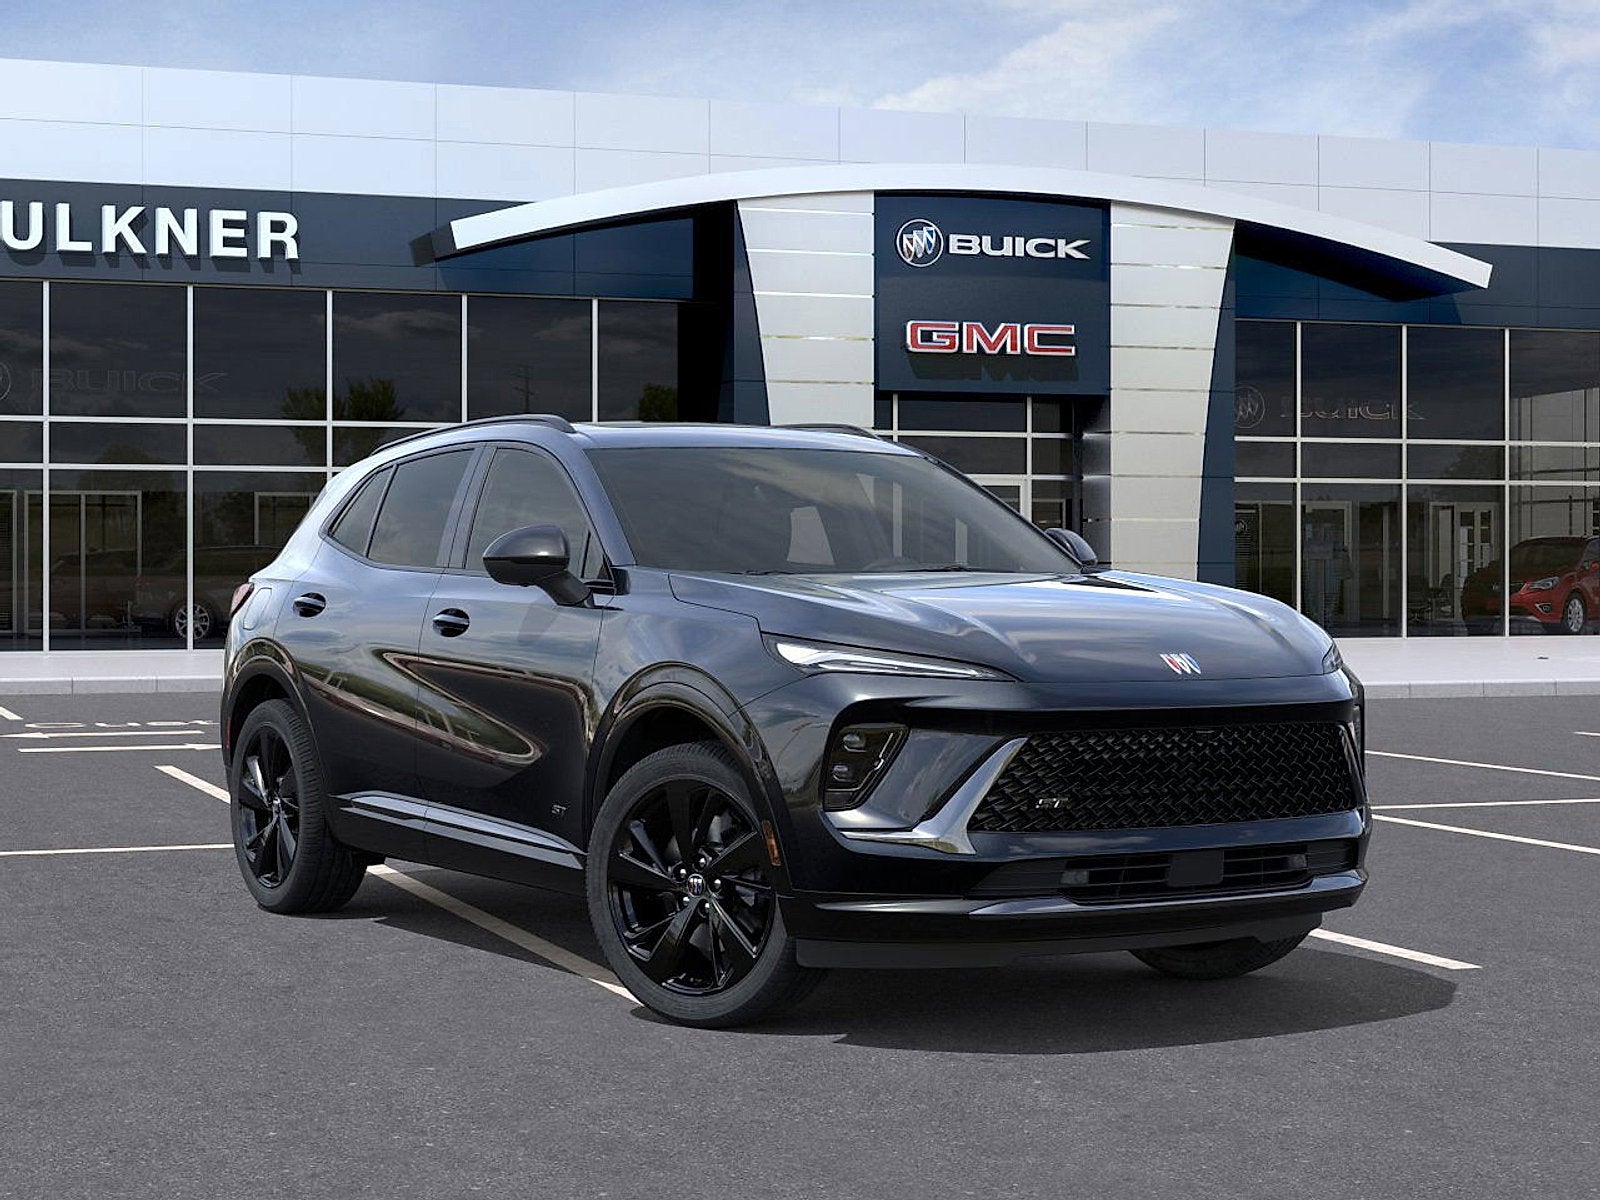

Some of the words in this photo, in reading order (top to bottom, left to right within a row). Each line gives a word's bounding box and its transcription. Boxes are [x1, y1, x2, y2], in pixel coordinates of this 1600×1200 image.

[0, 200, 299, 259] ULKNER
[948, 233, 1091, 259] BUICK
[906, 320, 1076, 356] GMC
